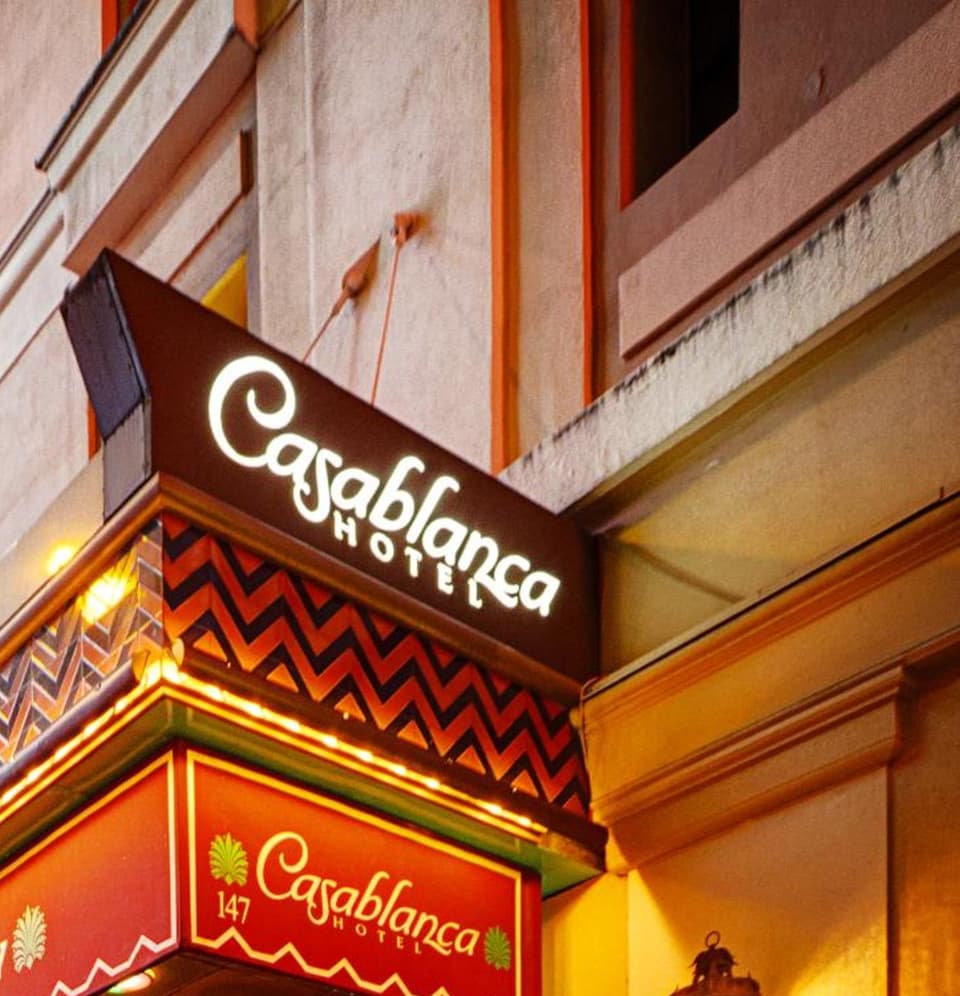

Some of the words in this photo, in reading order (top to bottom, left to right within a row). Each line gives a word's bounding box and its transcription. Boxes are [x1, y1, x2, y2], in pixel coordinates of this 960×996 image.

[208, 355, 561, 616] Casablanca
[333, 510, 484, 609] HOTEL
[217, 890, 250, 924] 147
[256, 831, 480, 957] Casablanca
[333, 916, 422, 955] HOTEL
